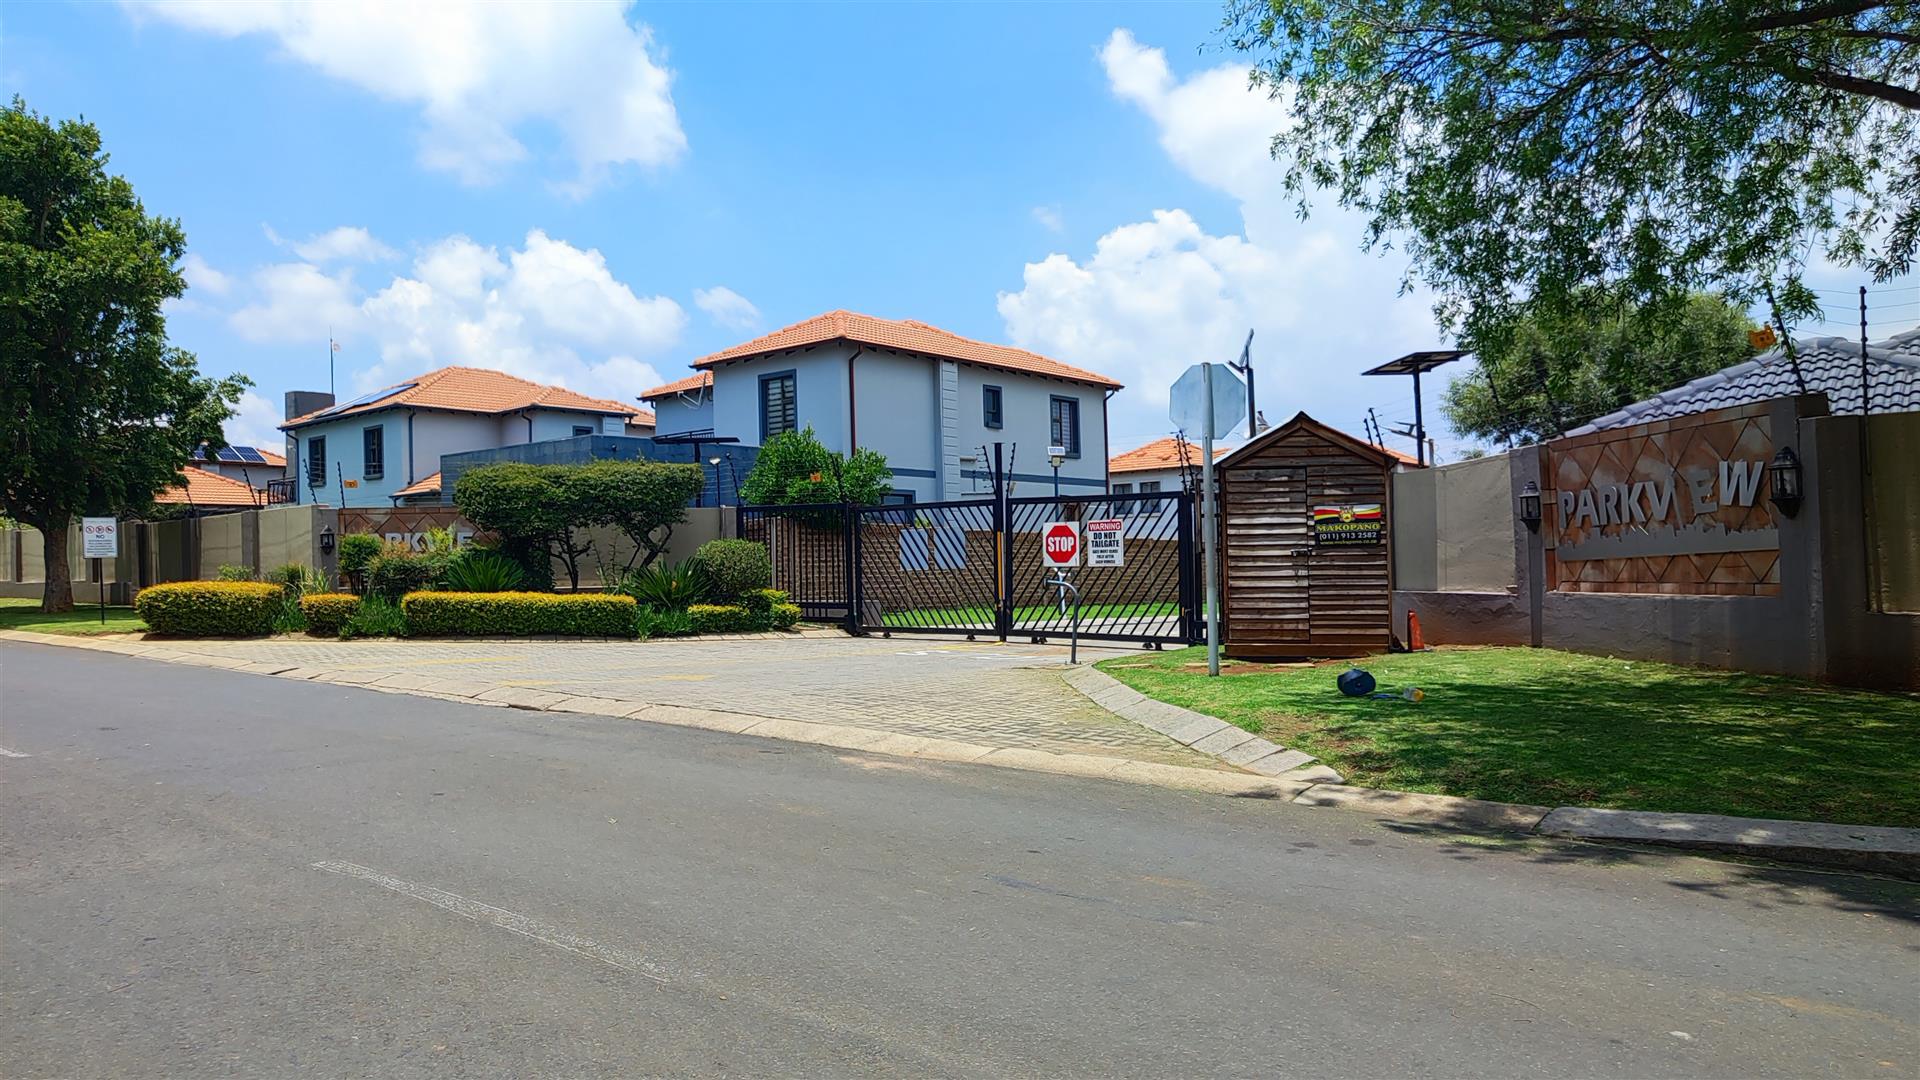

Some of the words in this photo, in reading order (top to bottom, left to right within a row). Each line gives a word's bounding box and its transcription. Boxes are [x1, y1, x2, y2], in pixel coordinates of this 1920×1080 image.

[1557, 459, 1767, 529] PARKVEW
[1089, 523, 1121, 531] WARNING
[1317, 524, 1380, 532] MAKOPANO
[1093, 532, 1102, 540] DO
[1104, 532, 1117, 540] NOT
[1319, 533, 1339, 541] (011)
[1047, 536, 1075, 552] STOP
[1091, 540, 1119, 548] TAILGATE
